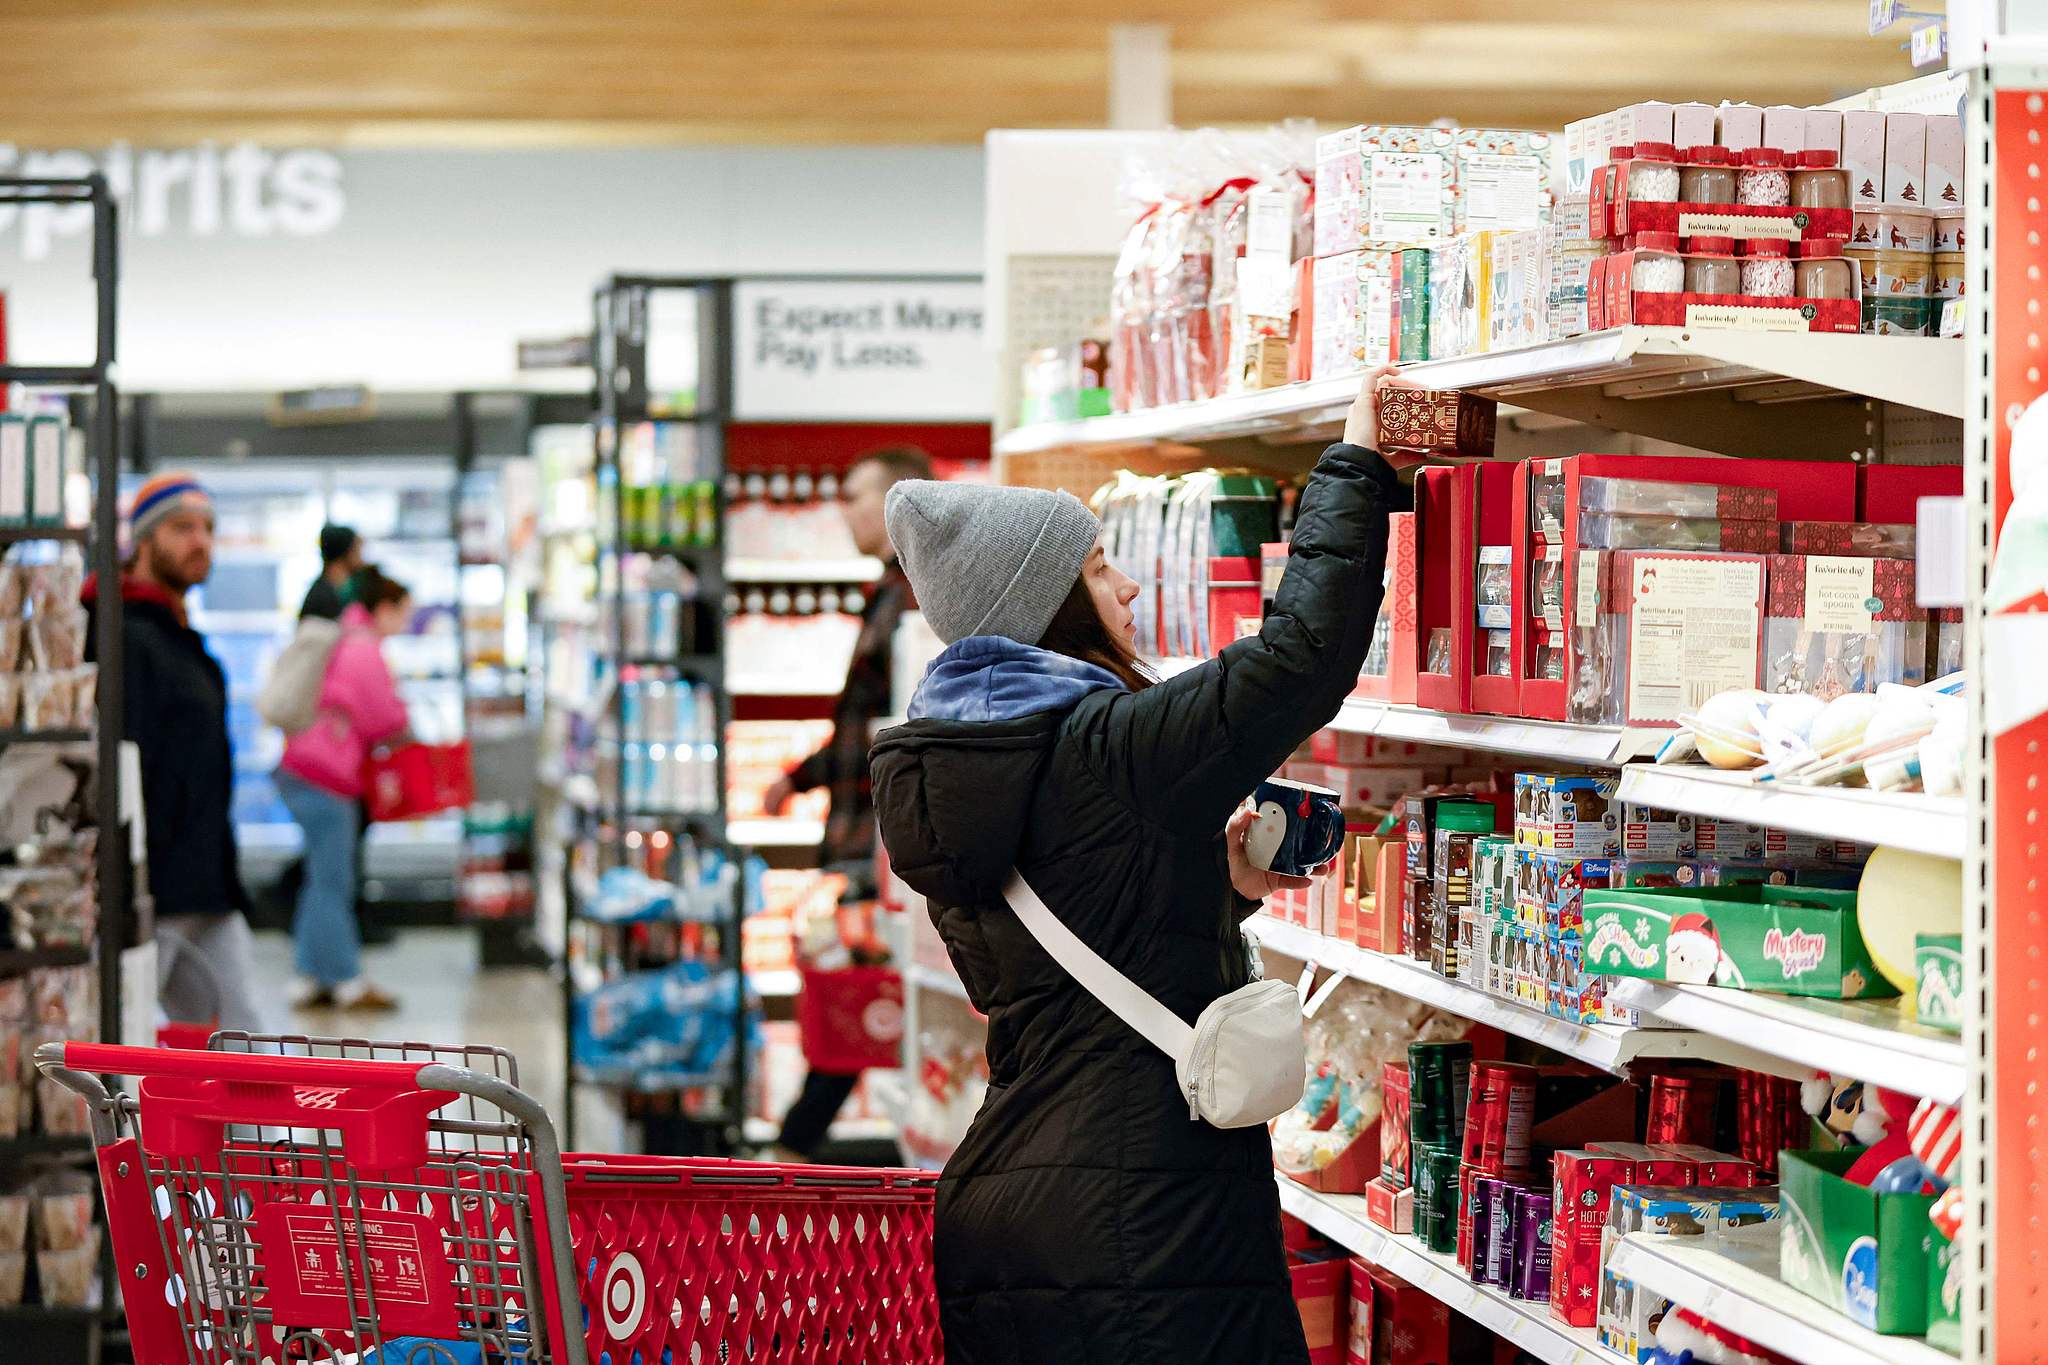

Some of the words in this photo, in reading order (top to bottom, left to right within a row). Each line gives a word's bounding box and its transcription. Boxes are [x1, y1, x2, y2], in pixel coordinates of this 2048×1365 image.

[0, 139, 348, 259] pirits
[756, 299, 881, 334] Expect
[756, 333, 818, 378] Pay
[1815, 564, 1848, 575] favorite
[1849, 566, 1865, 577] day
[1819, 590, 1833, 598] hot
[1823, 600, 1855, 610] spoons
[1584, 863, 1609, 874] Disney
[1766, 932, 1823, 960] Mystery
[1785, 953, 1815, 974] Squad
[1580, 1211, 1596, 1223] HOT
